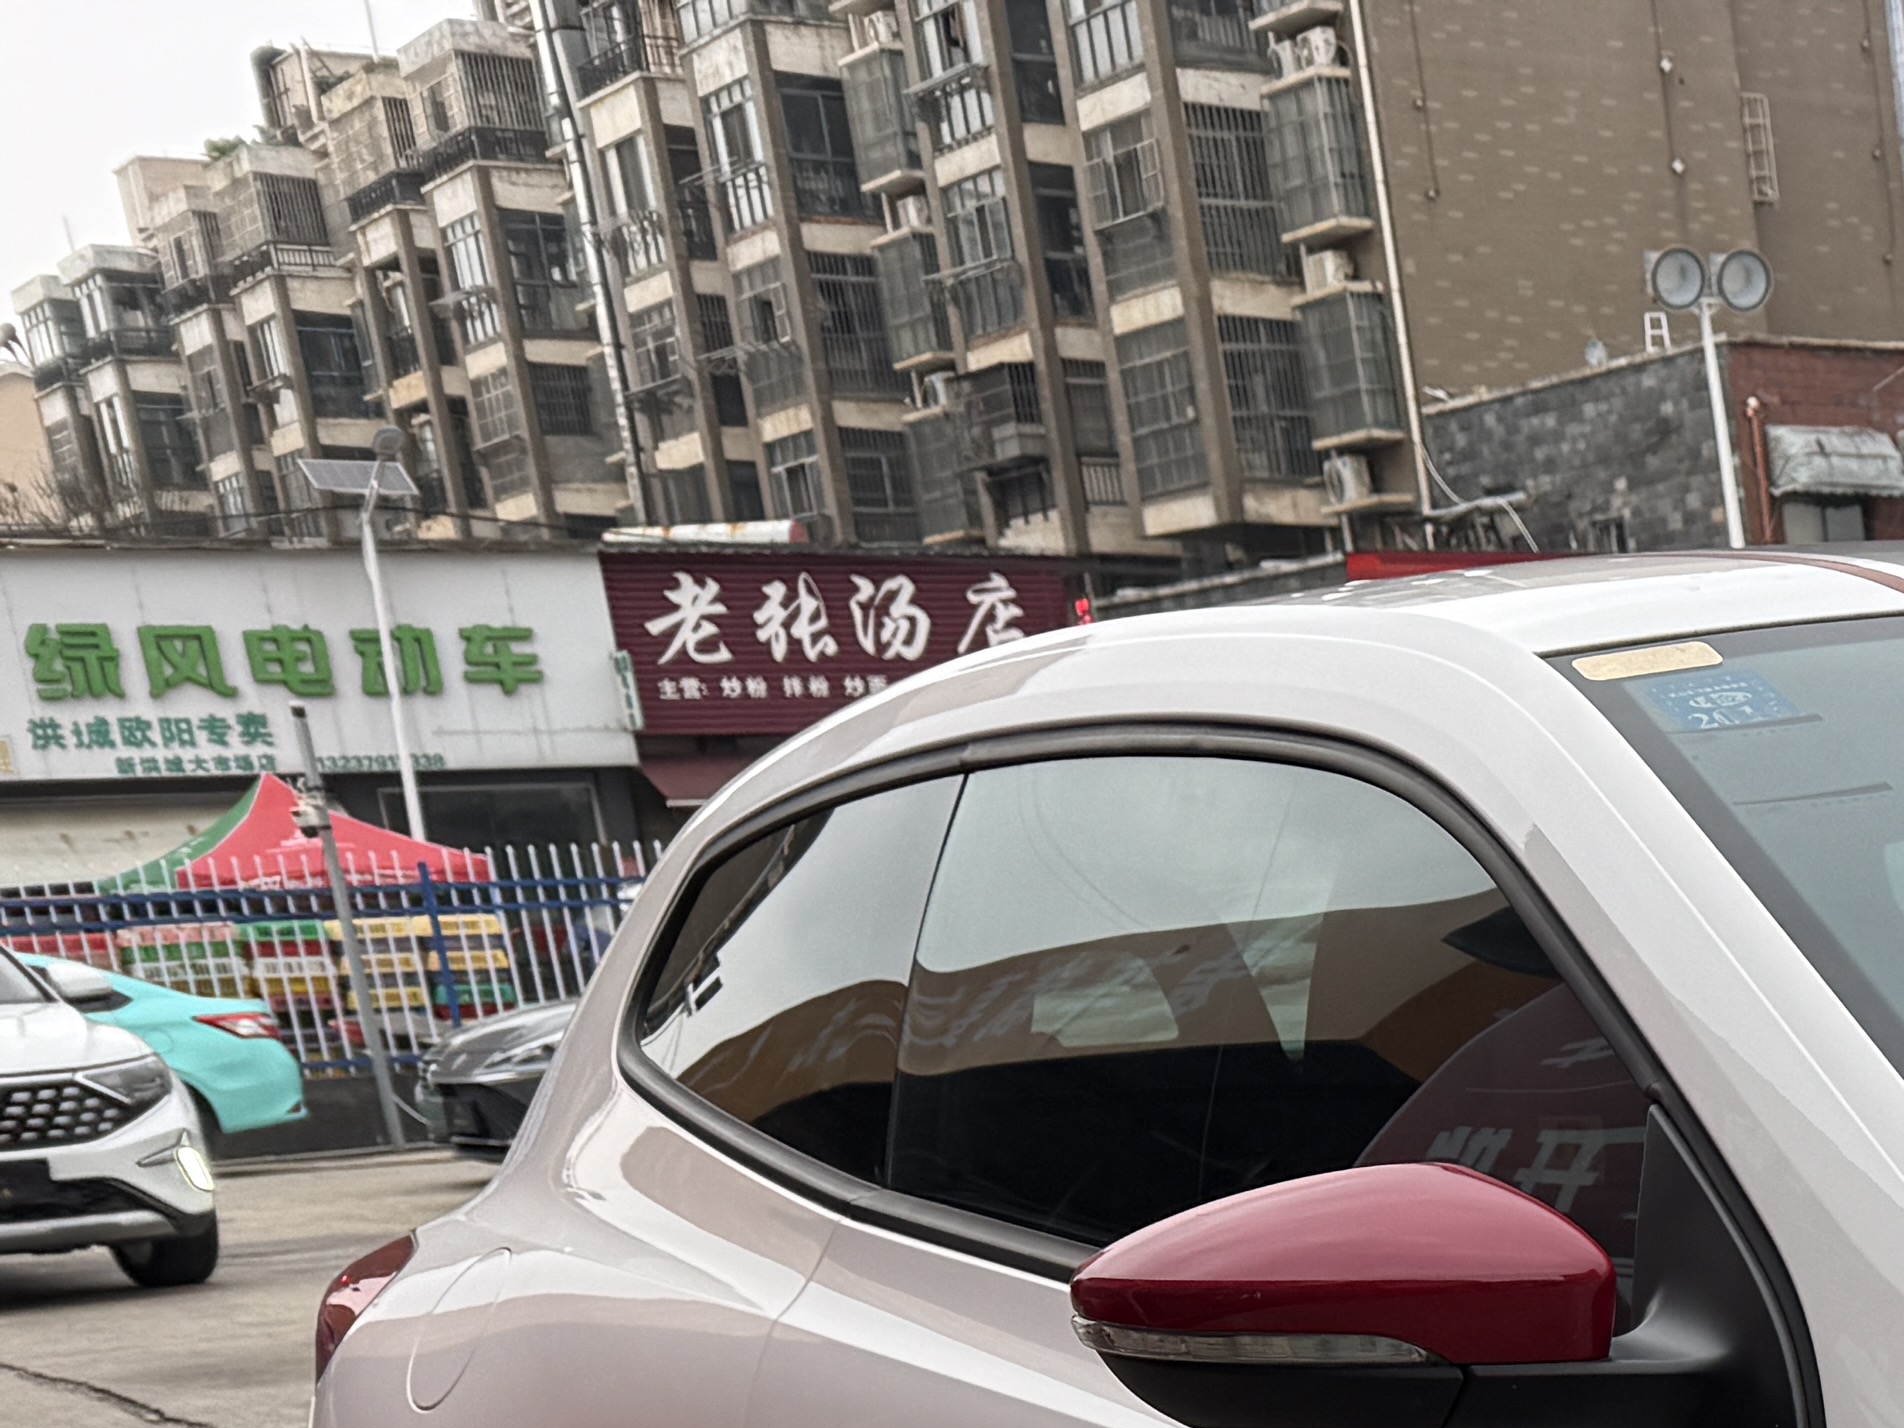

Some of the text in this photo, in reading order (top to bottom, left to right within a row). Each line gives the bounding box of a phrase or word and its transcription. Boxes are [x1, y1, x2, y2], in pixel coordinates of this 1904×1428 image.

[645, 571, 1025, 666] 老张汤店
[25, 622, 544, 700] 绿风电动车
[26, 711, 276, 751] 洪城欧阳专卖
